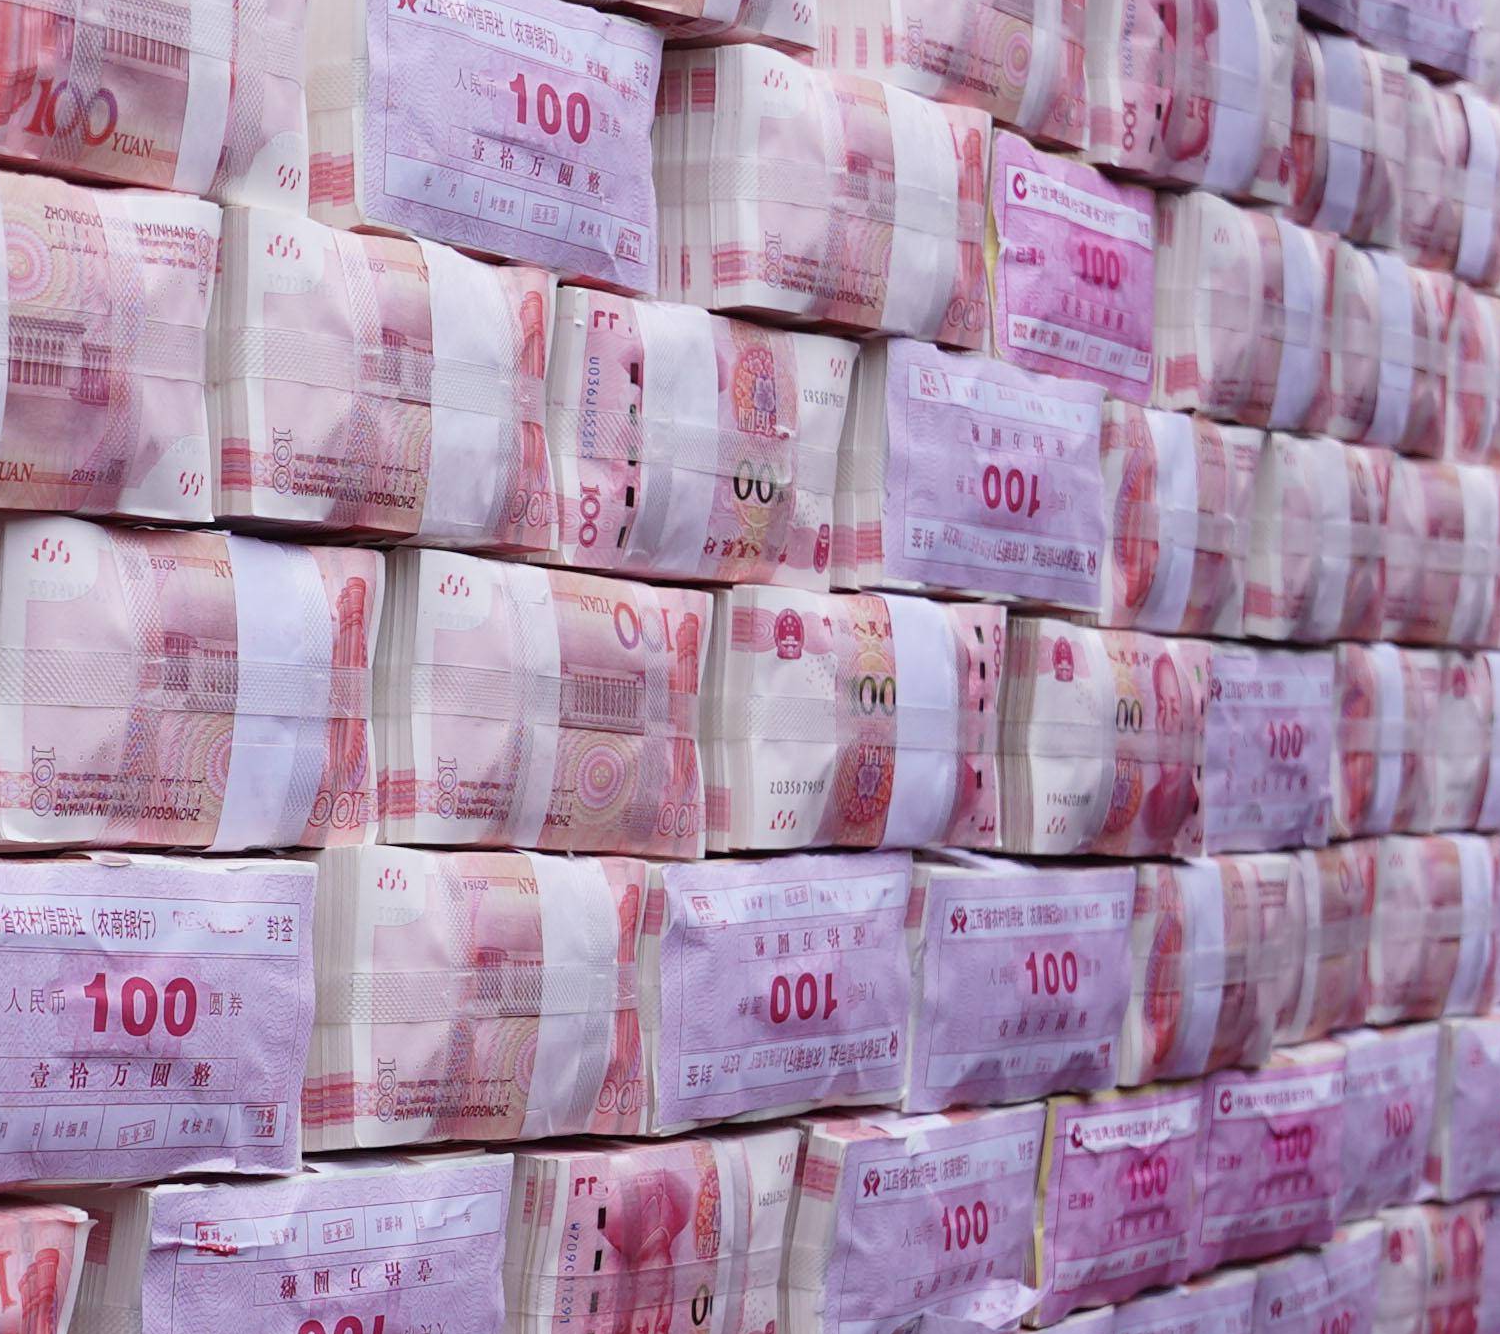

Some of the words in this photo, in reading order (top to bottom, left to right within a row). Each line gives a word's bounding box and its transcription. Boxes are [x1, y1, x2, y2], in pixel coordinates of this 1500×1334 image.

[25, 78, 118, 146] 100
[112, 132, 154, 158] YUAN
[509, 73, 591, 143] 100
[1121, 98, 1137, 151] 100
[472, 138, 600, 194] 壹拾万圆整
[44, 204, 104, 228] ZHONGGUO
[1078, 240, 1121, 290] 100
[365, 491, 416, 509] ZHONGGUO
[733, 459, 773, 504] 00
[983, 465, 1040, 518] 100
[579, 482, 600, 548] 100
[150, 558, 176, 570] 2015
[580, 595, 613, 615] YUAN
[860, 676, 896, 716] 00
[1116, 699, 1142, 732] 00
[1268, 721, 1303, 761] 100
[141, 807, 200, 821] ZHONGGUO
[657, 803, 695, 837] 100
[267, 916, 293, 942] 封签
[1025, 951, 1077, 995] 100
[4, 988, 66, 1014] 人民币
[84, 973, 197, 1037] 100
[209, 992, 243, 1016] 圆券
[769, 973, 837, 1024] 100
[30, 1063, 212, 1089] 壹拾万圆整
[462, 1104, 509, 1117] ZHONGGUO
[598, 1079, 643, 1115] 100
[1274, 1123, 1312, 1163] 100
[1128, 1157, 1168, 1200] 100
[942, 1201, 987, 1251] 100
[279, 1258, 431, 1299] 壹拾万圆整
